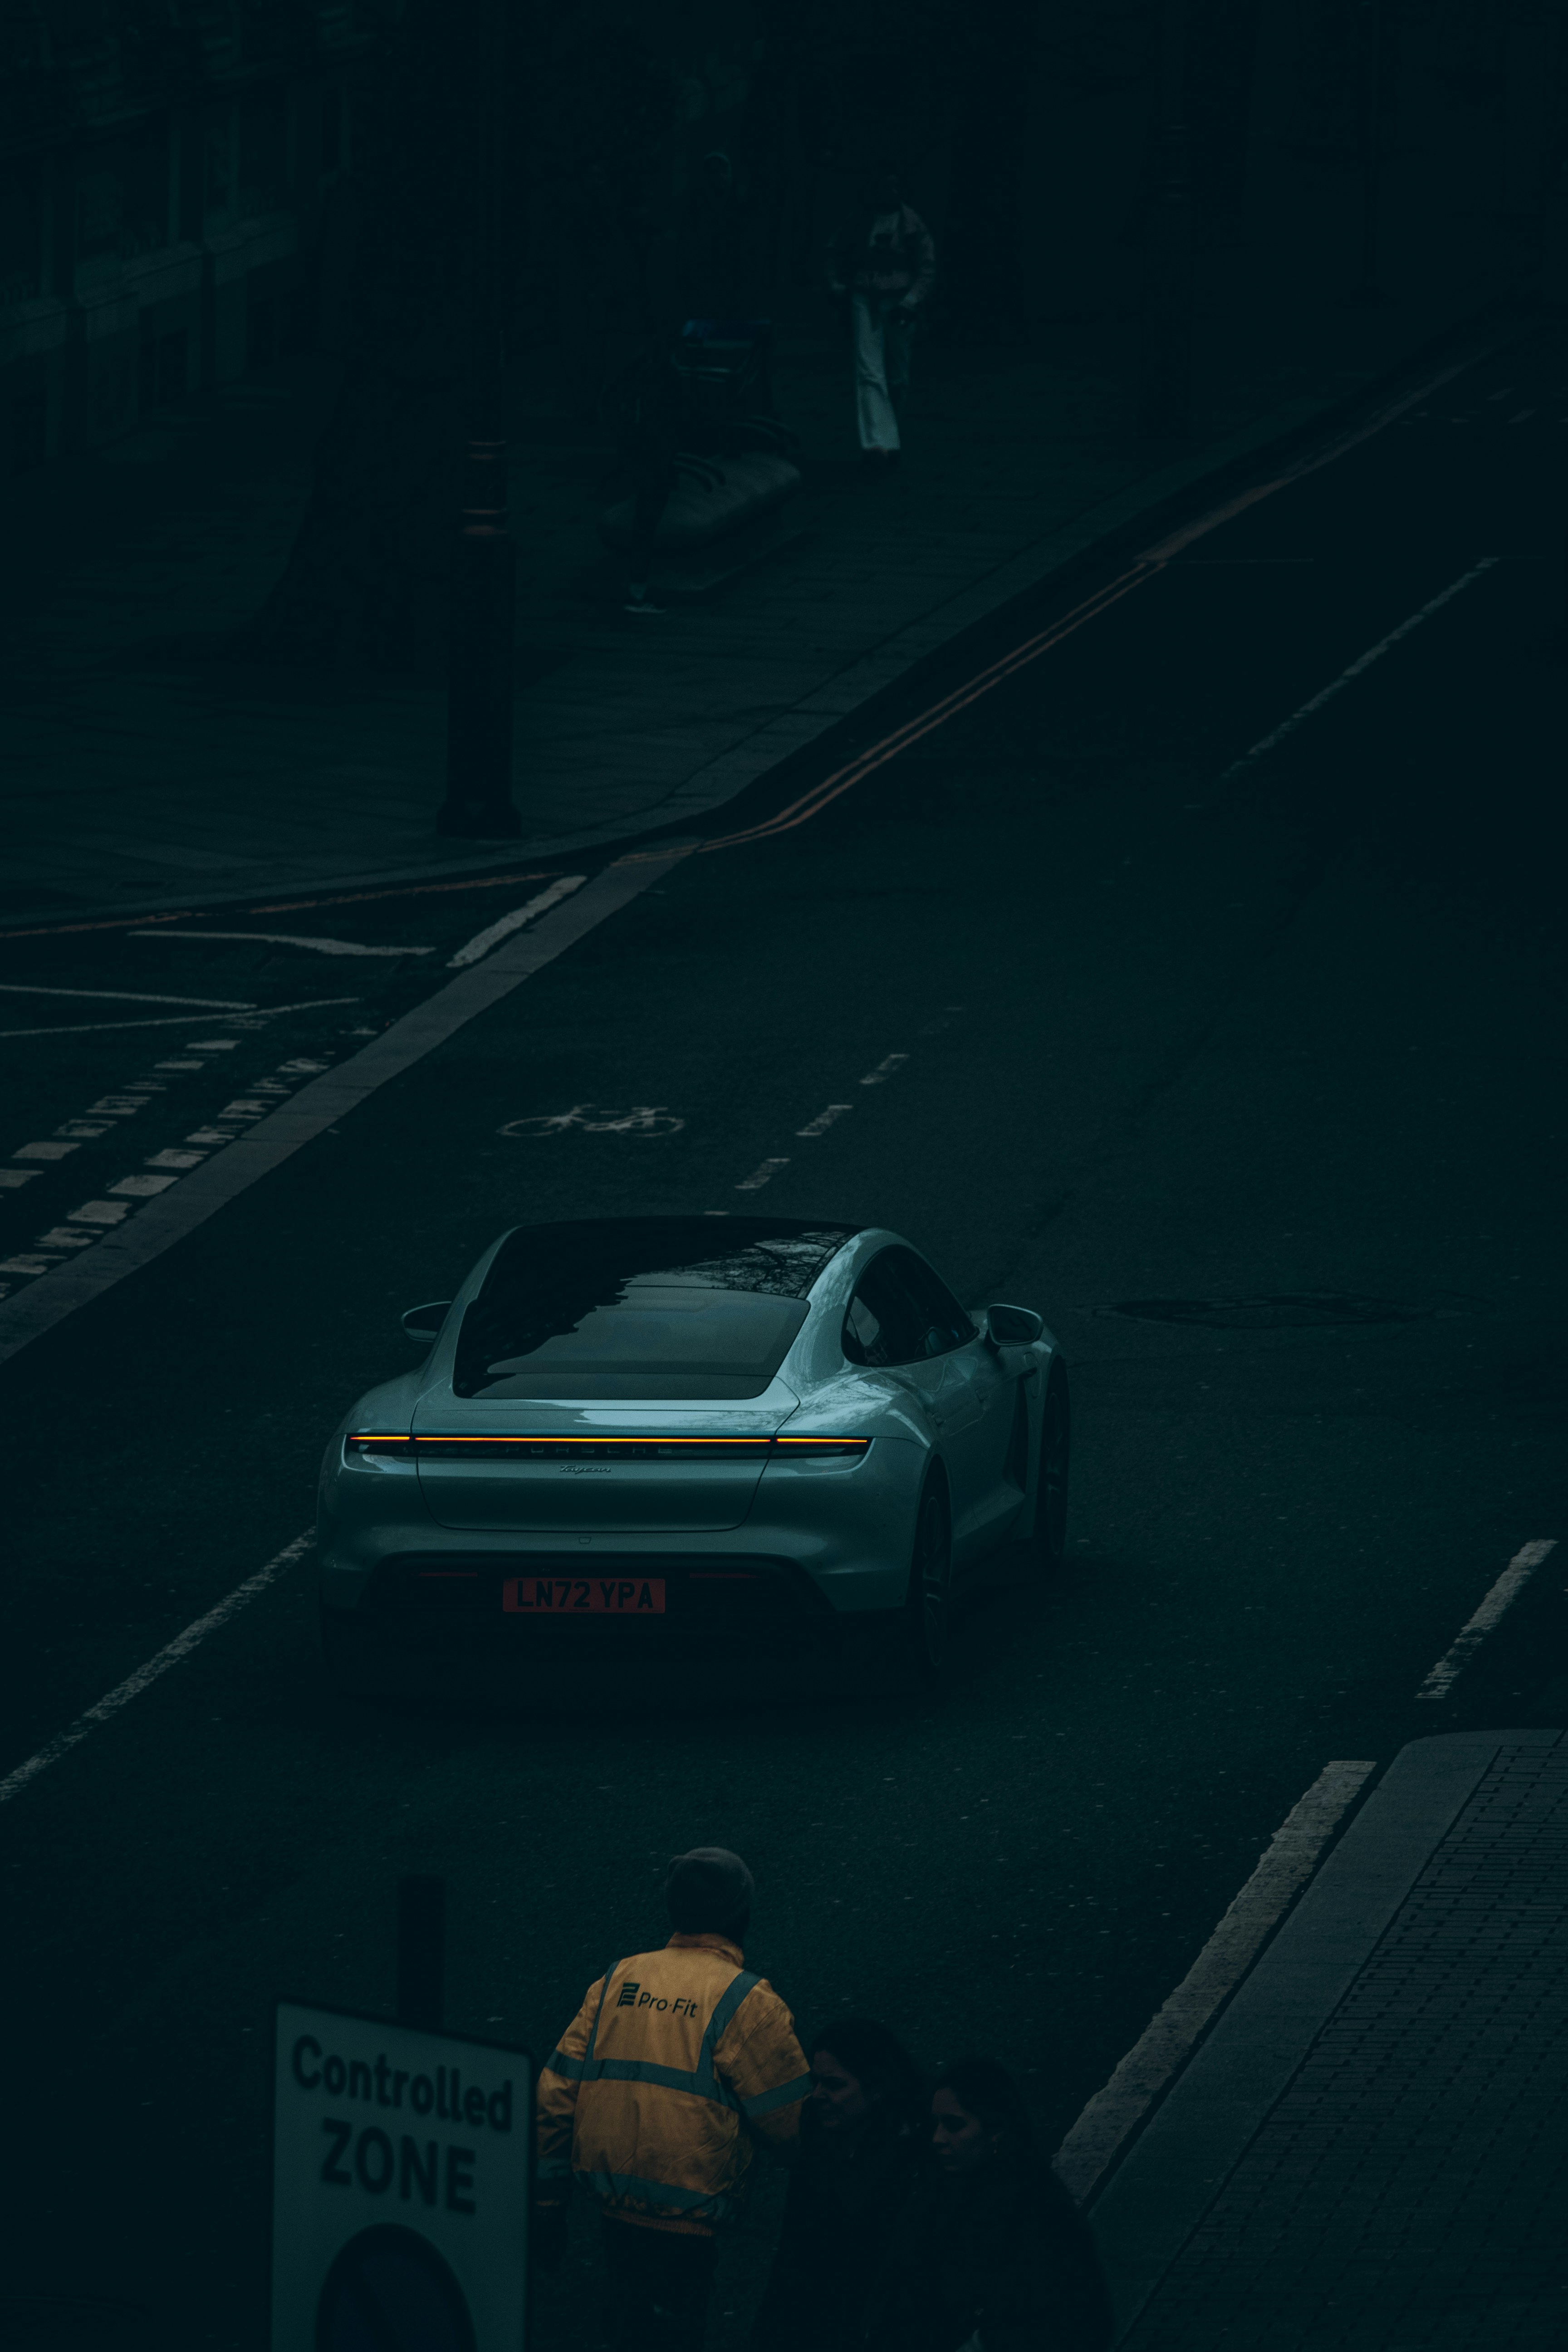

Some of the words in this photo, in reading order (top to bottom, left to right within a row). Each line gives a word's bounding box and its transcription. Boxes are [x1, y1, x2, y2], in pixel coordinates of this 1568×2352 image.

[506, 1445, 672, 1454] PORSCHE
[560, 1465, 611, 1474] Taycan
[517, 1581, 590, 1607] LN72
[599, 1582, 653, 1608] YPA
[292, 2034, 513, 2134] Controlled
[320, 2116, 476, 2215] ZONE
